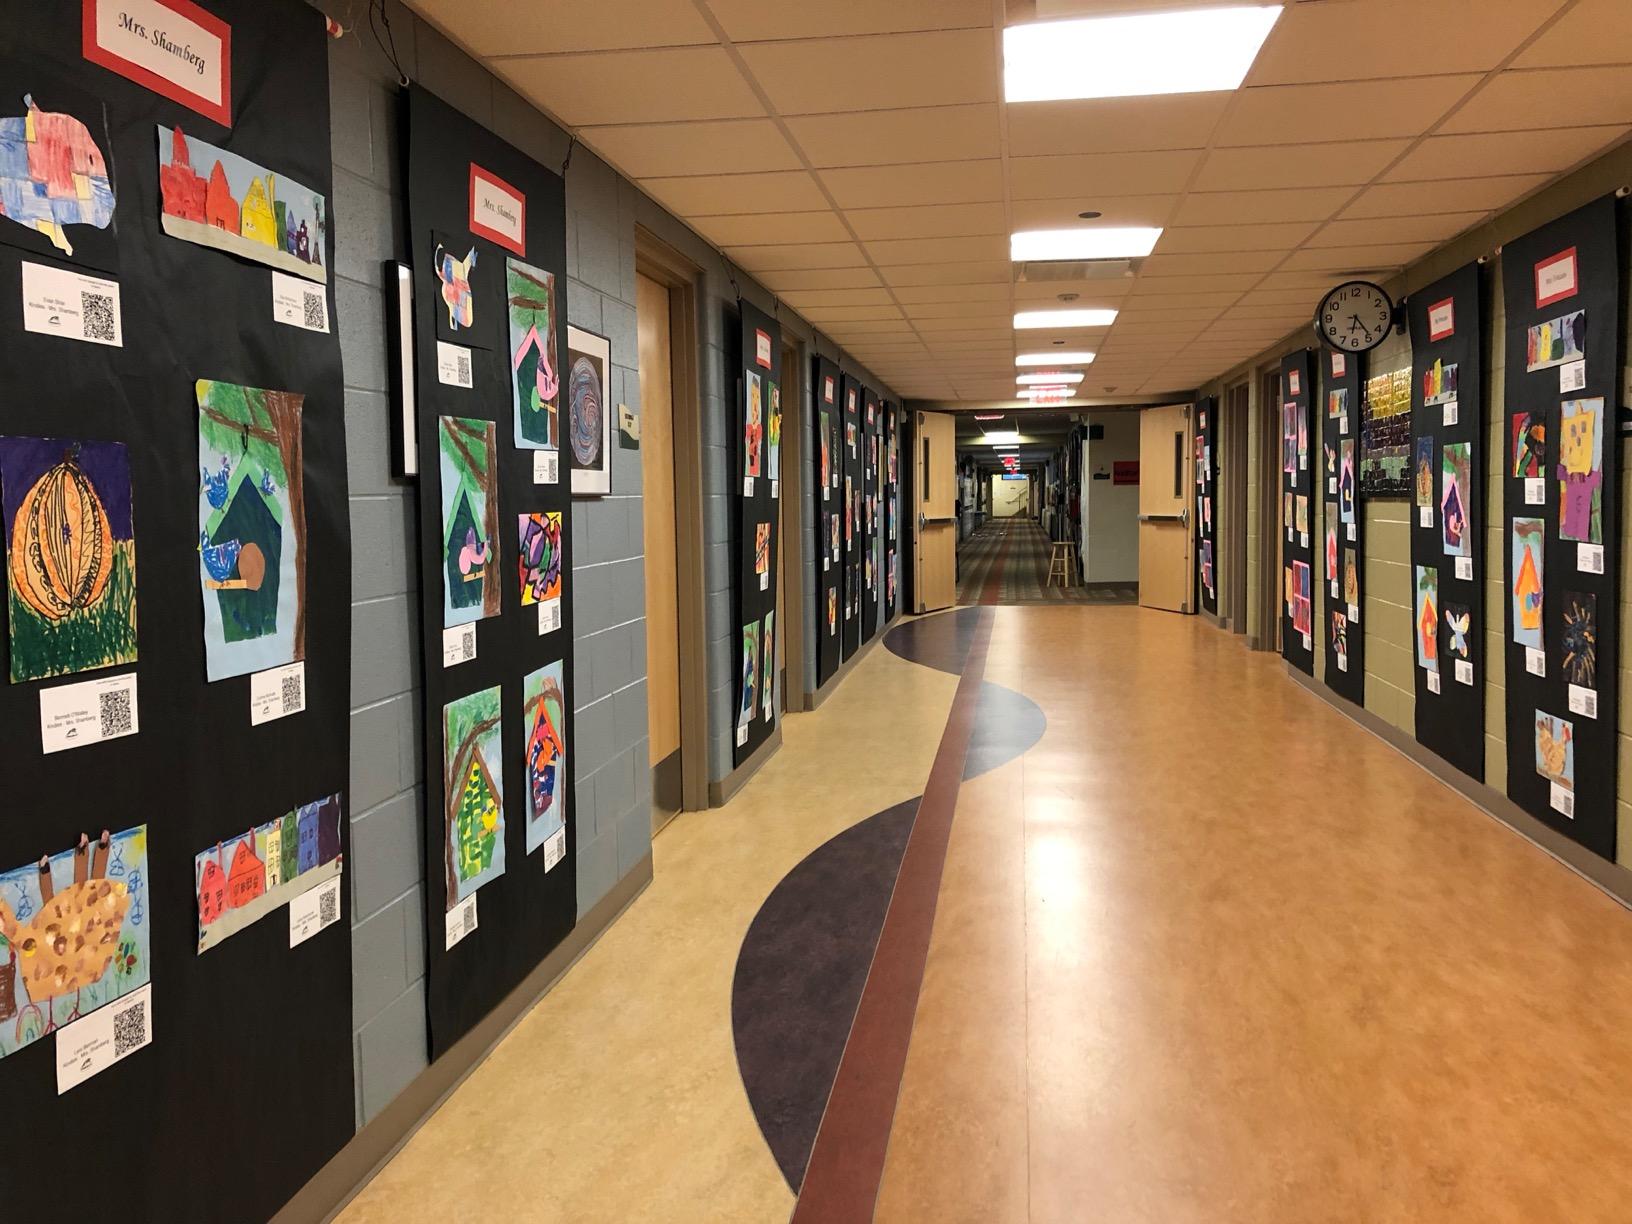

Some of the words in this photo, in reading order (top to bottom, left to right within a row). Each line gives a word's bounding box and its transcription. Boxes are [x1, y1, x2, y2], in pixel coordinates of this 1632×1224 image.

[118, 12, 148, 40] Mrs.
[151, 30, 206, 74] Shamberg
[1340, 292, 1346, 301] 11
[1351, 288, 1360, 297] 12
[1329, 302, 1340, 311] 10
[1374, 298, 1382, 308] 2
[1325, 314, 1332, 323] 9
[1379, 312, 1387, 320] 3
[1329, 327, 1336, 336] 8
[1374, 324, 1382, 333] 4
[1340, 336, 1346, 344] 7
[1352, 338, 1359, 347] 6
[1365, 334, 1372, 343] 5
